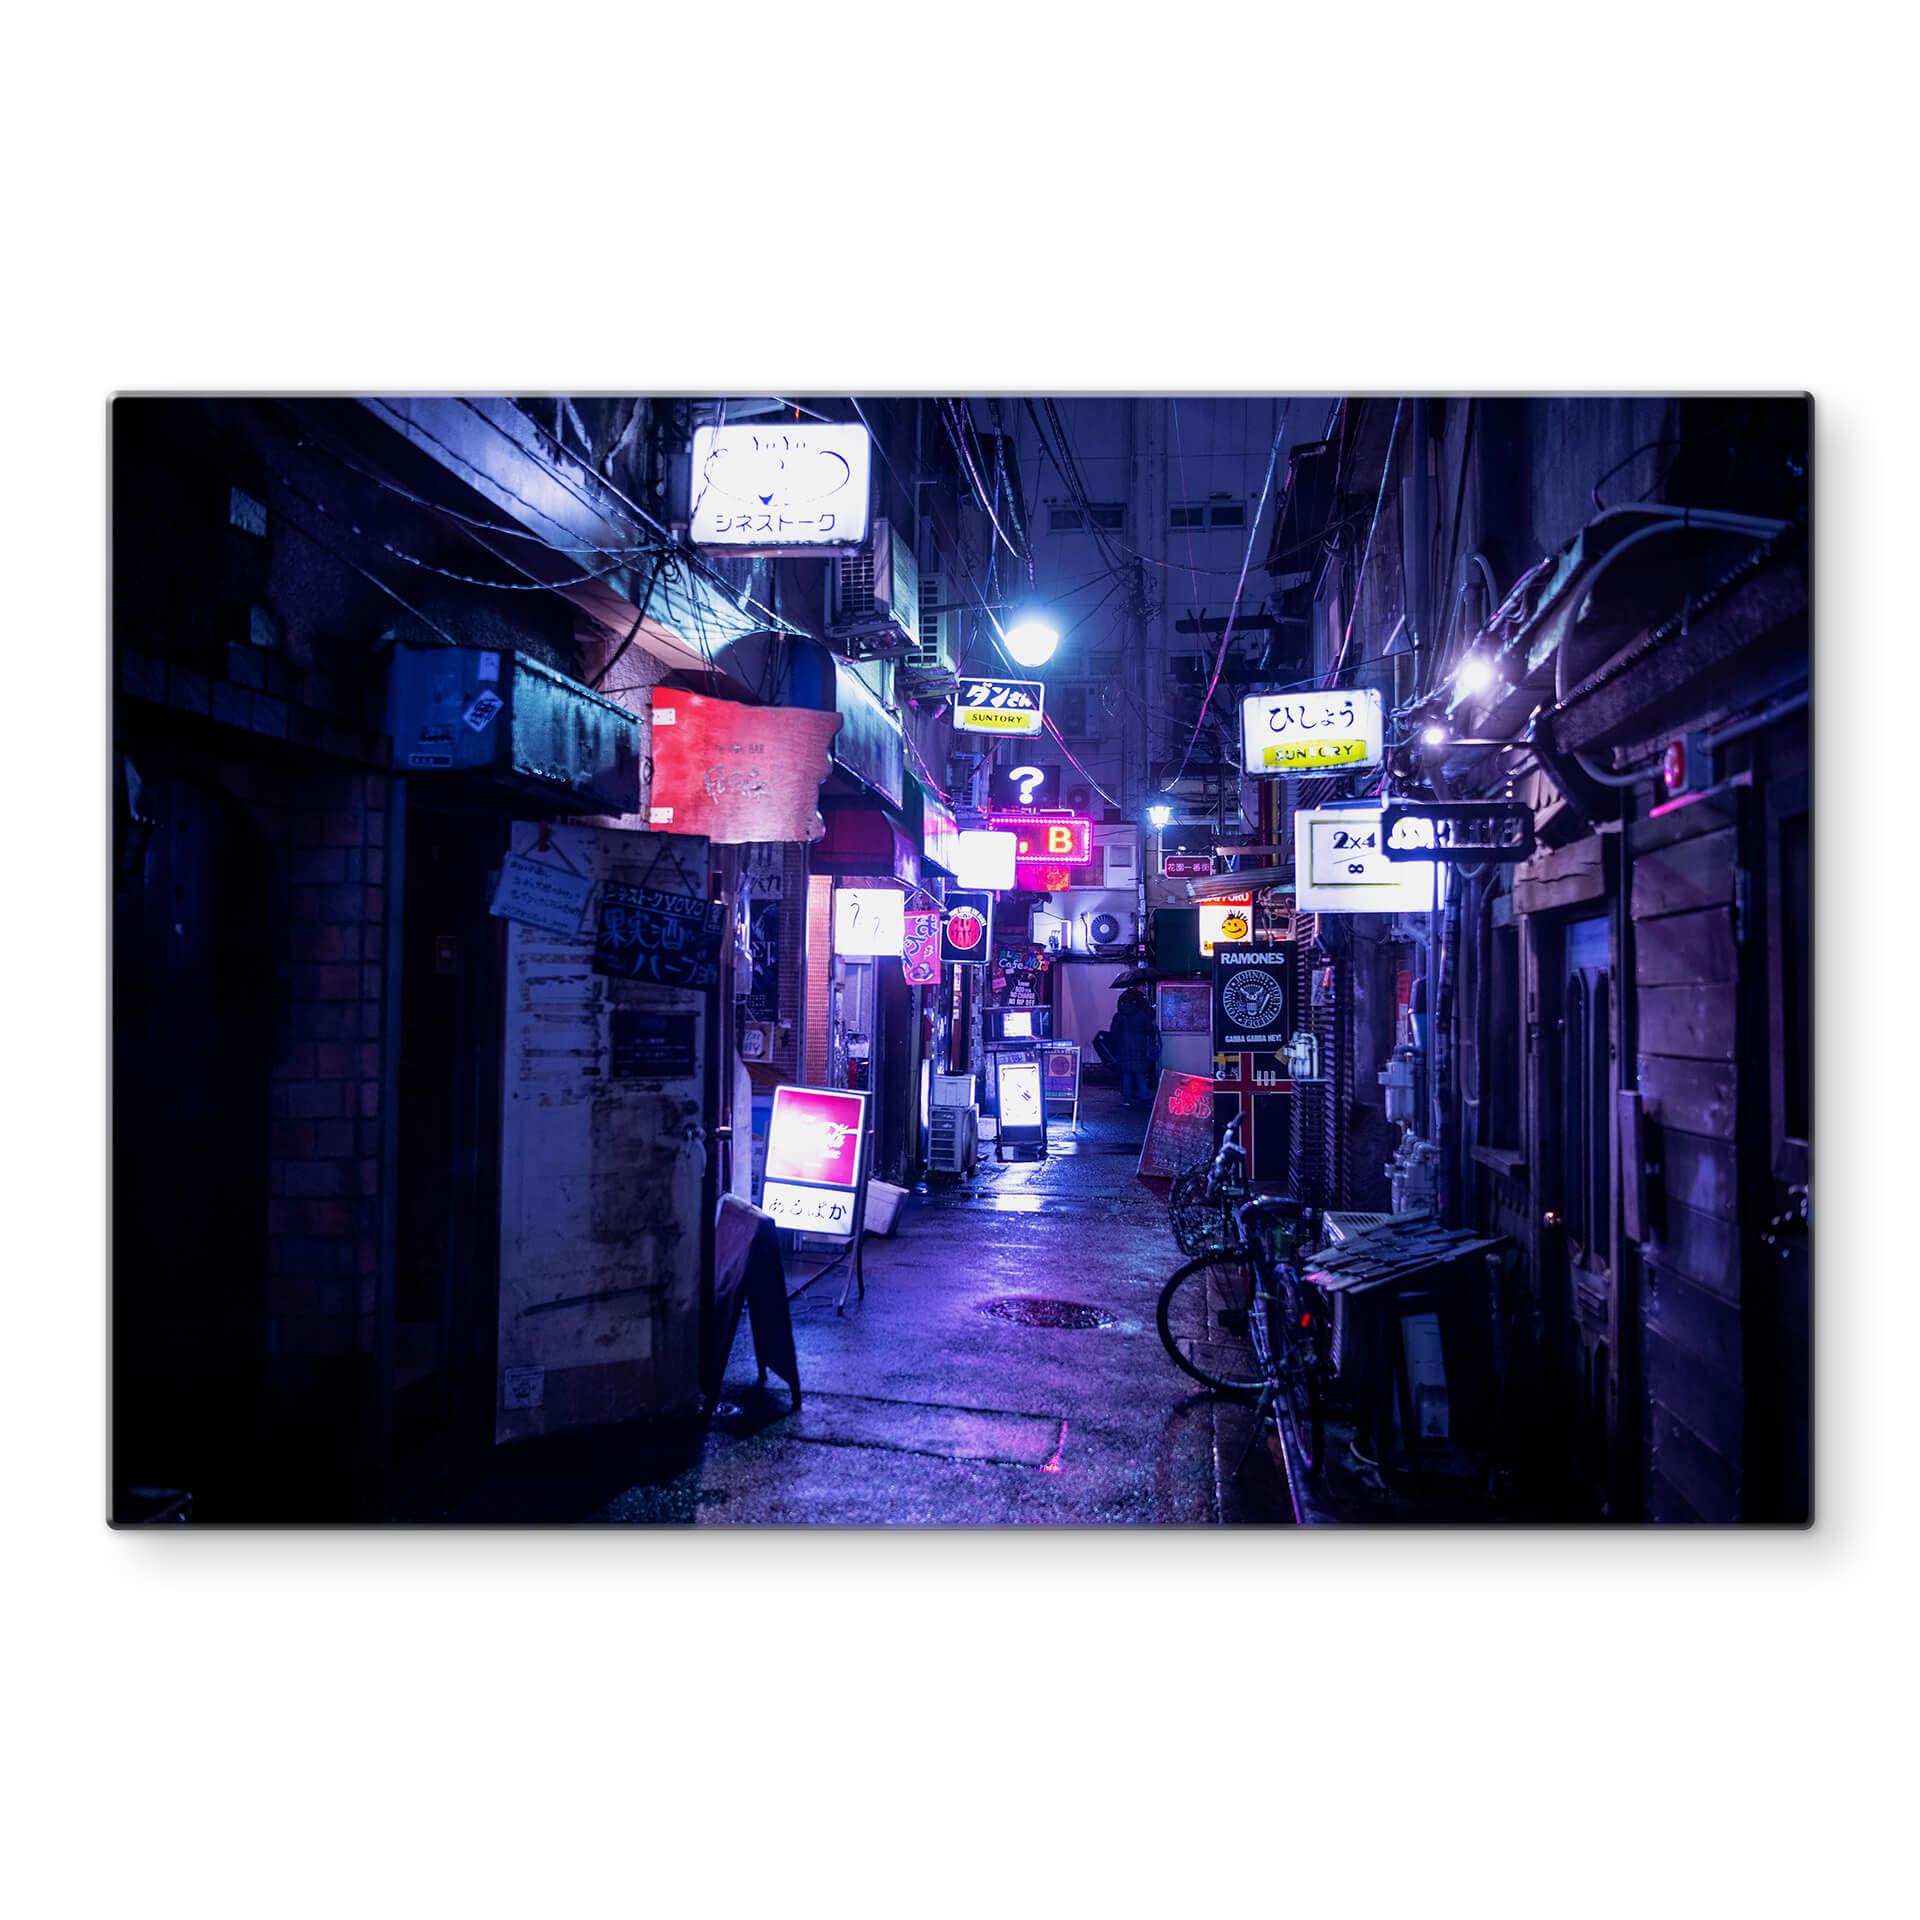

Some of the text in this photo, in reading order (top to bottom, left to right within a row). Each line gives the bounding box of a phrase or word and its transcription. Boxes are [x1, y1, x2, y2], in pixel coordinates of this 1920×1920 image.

[715, 513, 836, 533] シネストーク
[966, 681, 1034, 709] ダンさん
[971, 713, 1023, 724] SUNTORY
[1269, 701, 1355, 733] ひしょう
[1220, 952, 1285, 965] RAMONES
